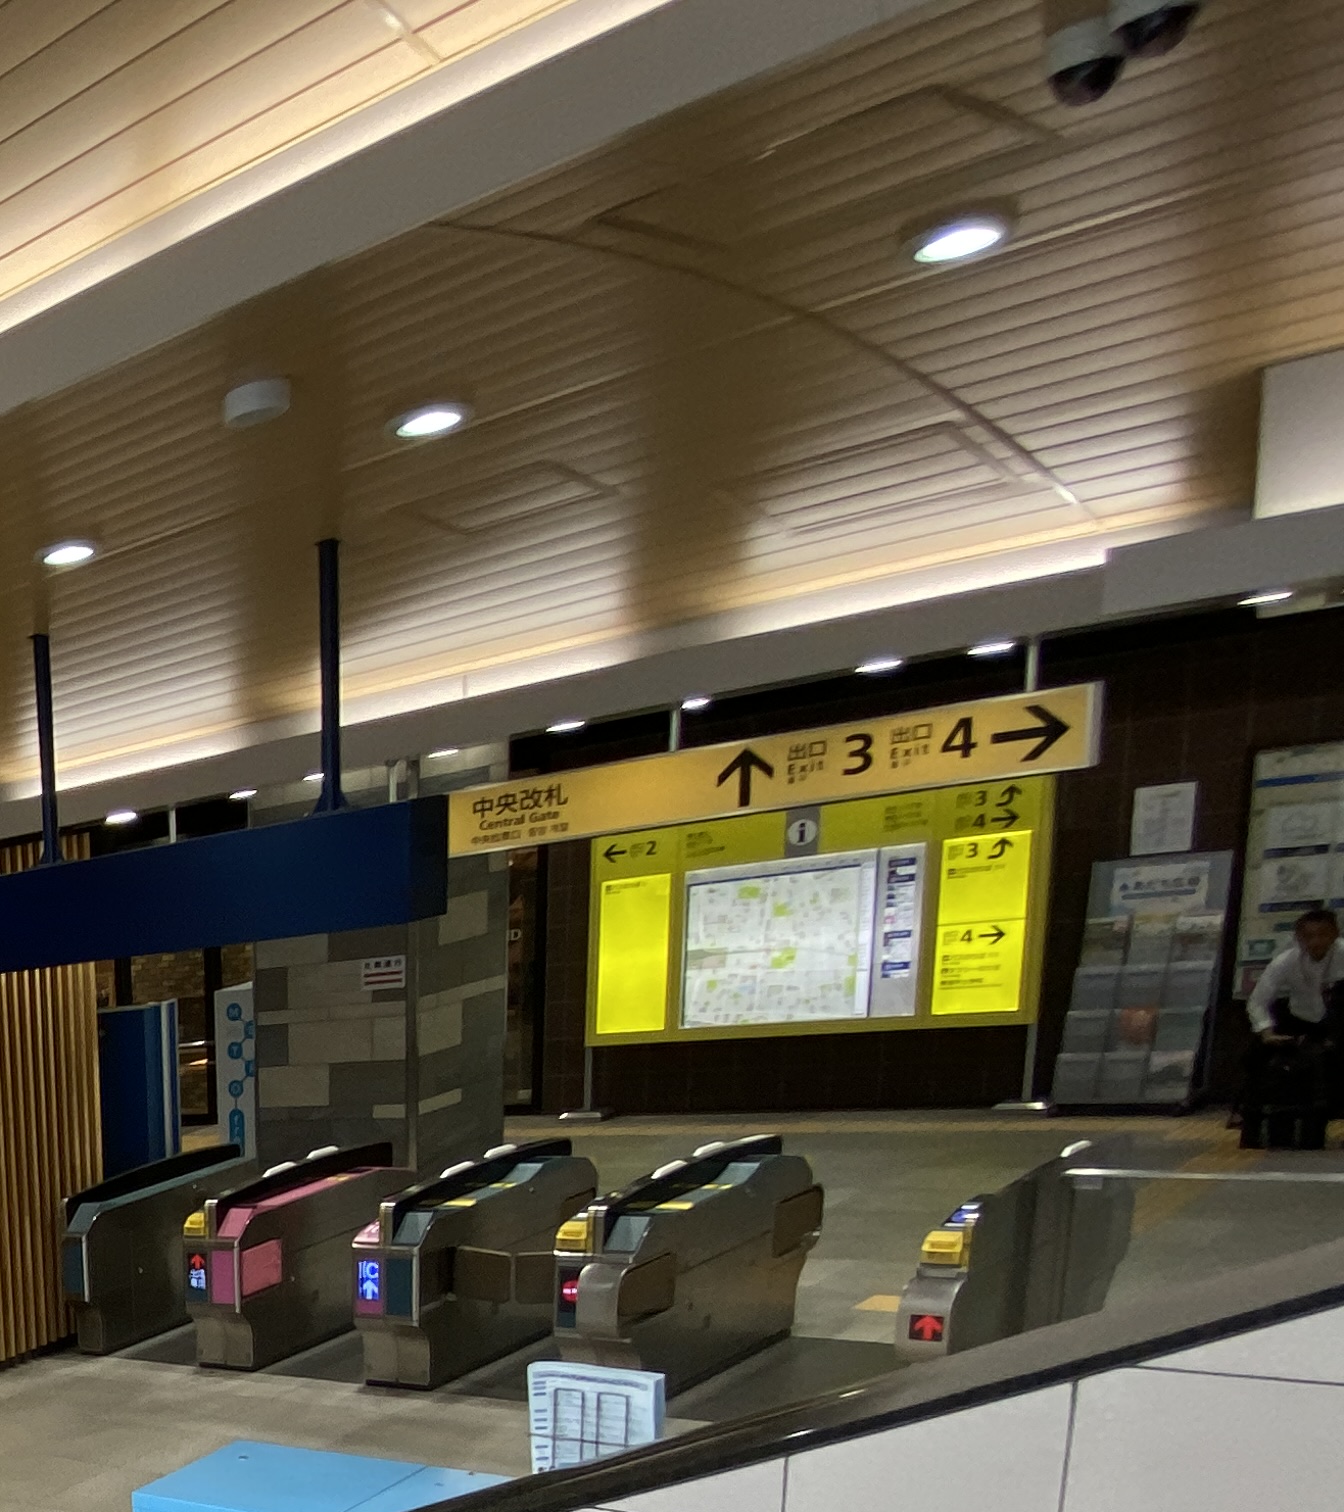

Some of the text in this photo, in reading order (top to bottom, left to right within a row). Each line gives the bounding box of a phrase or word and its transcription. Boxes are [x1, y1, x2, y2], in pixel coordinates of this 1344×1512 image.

[891, 716, 978, 758] 出口 4
[788, 733, 873, 776] 出口 3
[890, 744, 930, 760] Exit
[788, 761, 824, 775] Exit
[472, 783, 569, 818] 中央改札
[975, 790, 988, 806] 3
[480, 811, 560, 831] Central Gate
[972, 813, 986, 828] 4
[646, 840, 657, 856] 2
[966, 843, 979, 858] 3
[960, 929, 973, 944] 4
